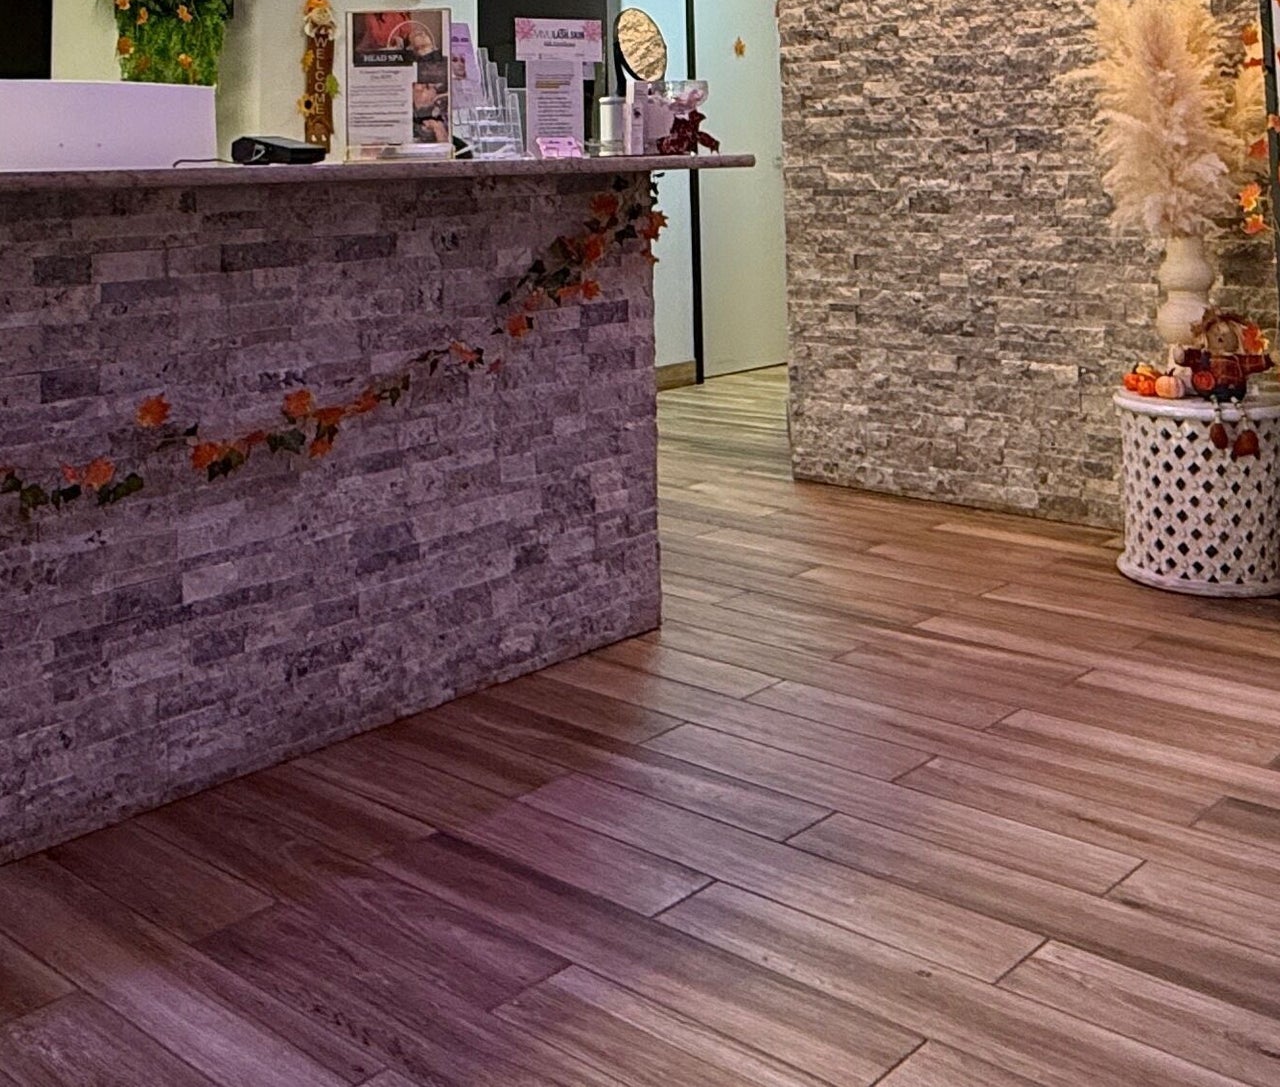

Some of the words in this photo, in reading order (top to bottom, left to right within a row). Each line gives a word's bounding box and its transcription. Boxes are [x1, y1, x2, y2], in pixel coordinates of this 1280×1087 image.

[314, 36, 328, 115] WELCOME
[363, 54, 387, 62] HEAD
[387, 54, 404, 62] SPA
